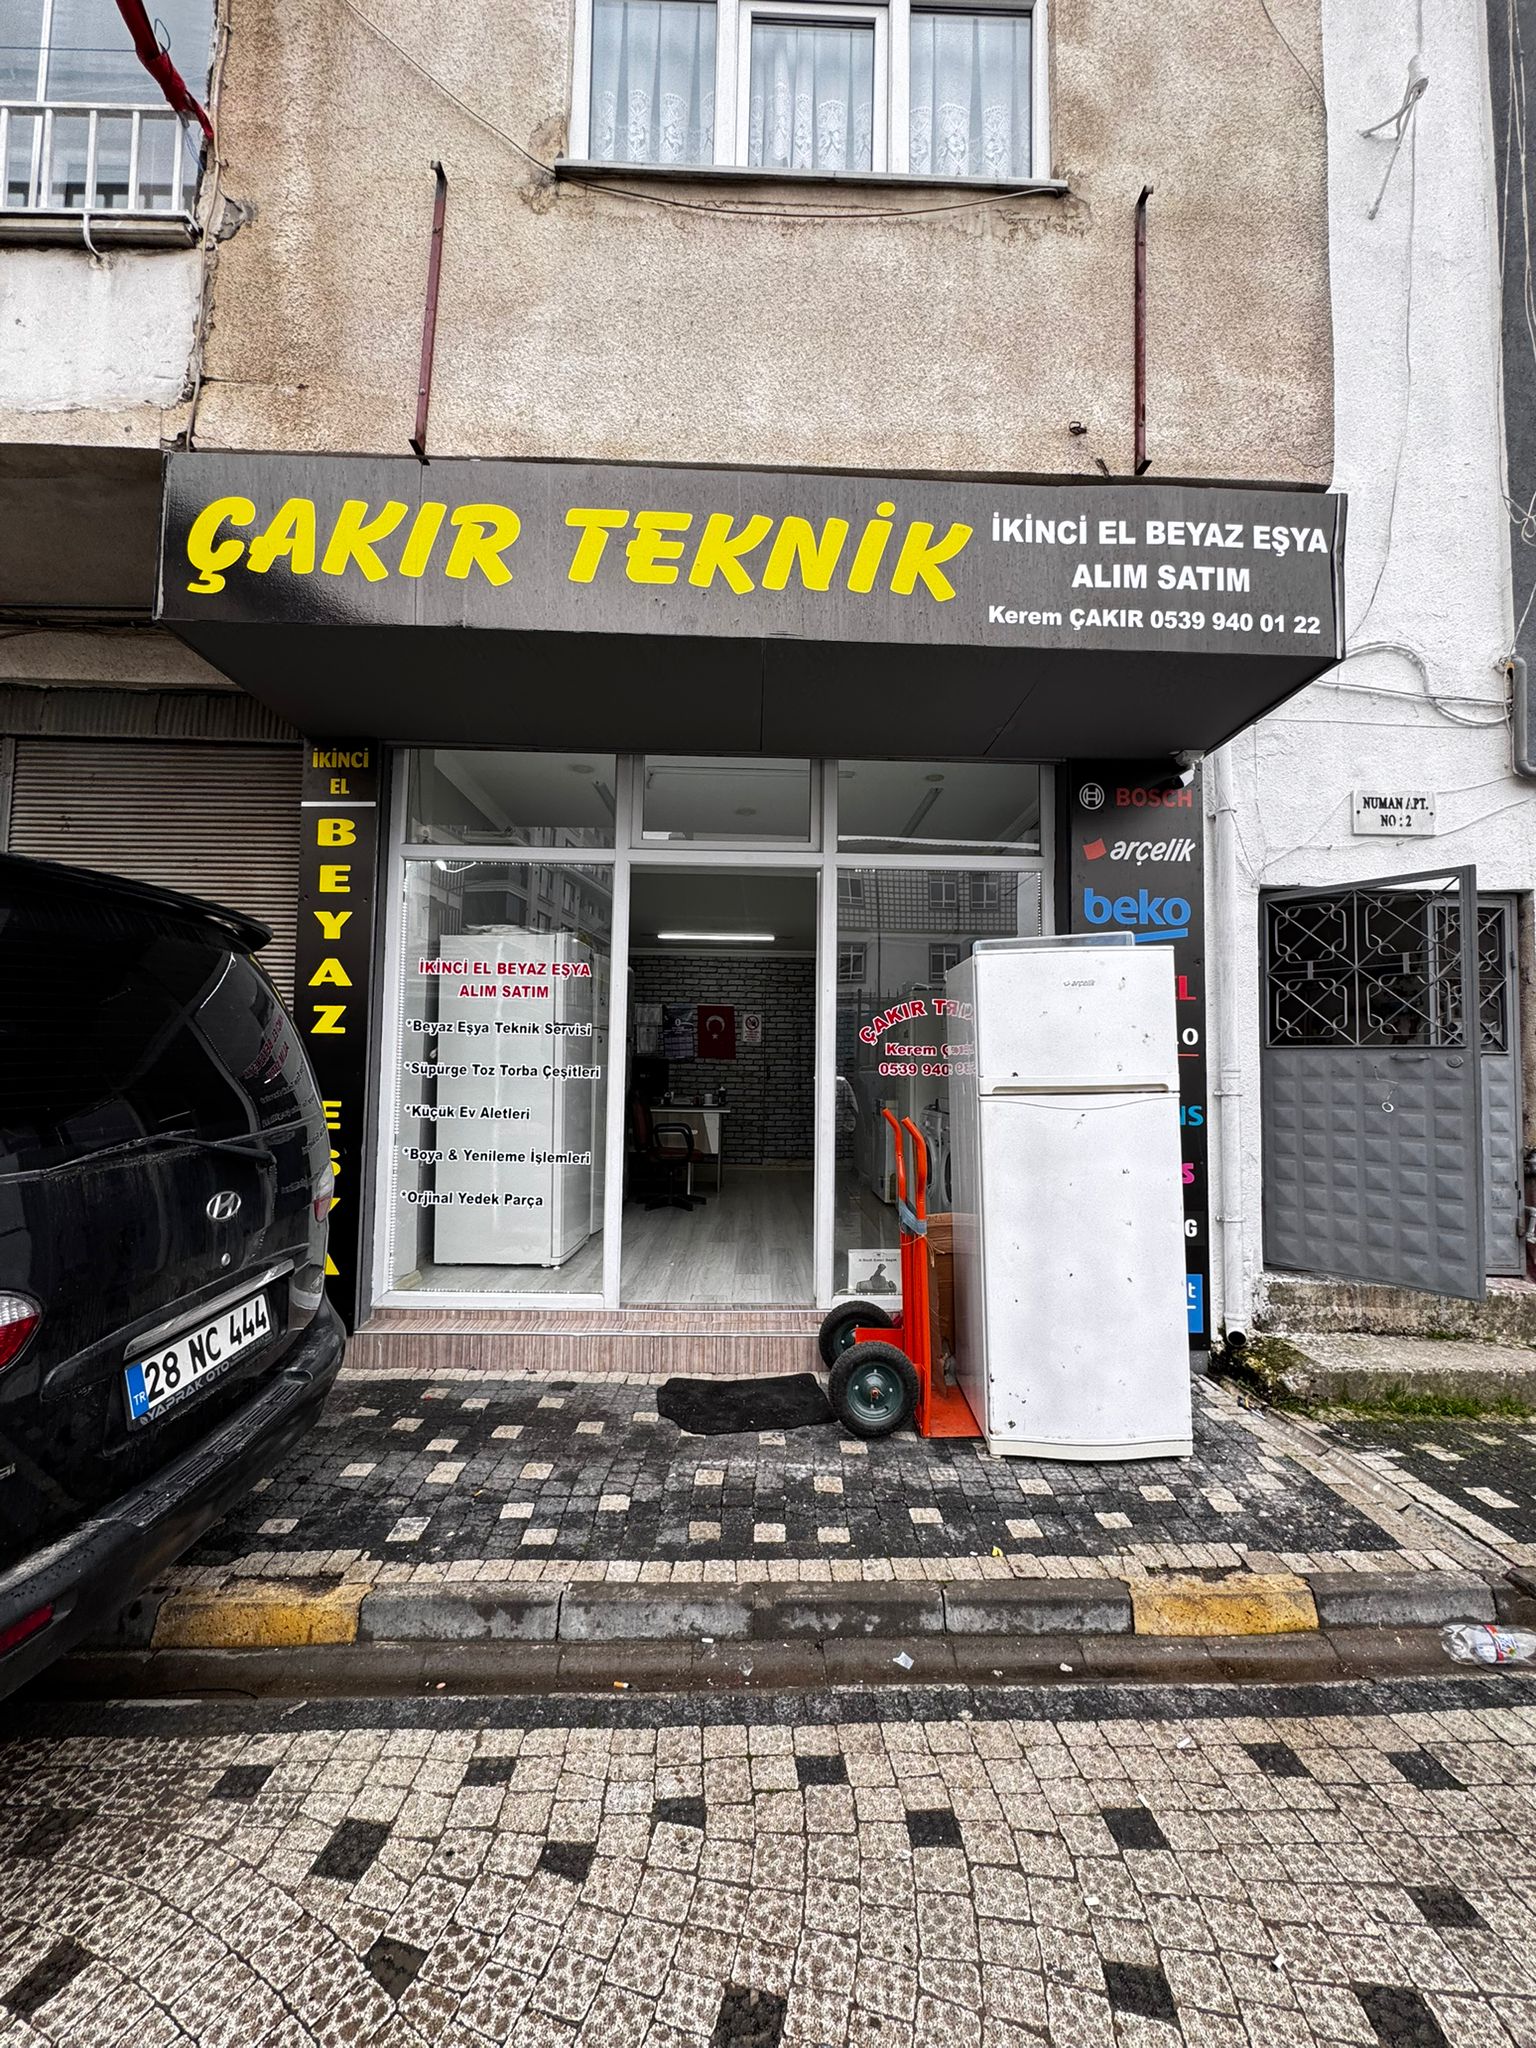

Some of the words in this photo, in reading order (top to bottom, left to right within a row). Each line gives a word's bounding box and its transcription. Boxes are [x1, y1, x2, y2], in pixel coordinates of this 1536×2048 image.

[992, 512, 1087, 545] İKİNCİ
[1099, 520, 1136, 545] EL
[1147, 521, 1243, 549] BEYAZ
[1253, 525, 1329, 557] EŞYA
[187, 496, 521, 594] ÇAKIR
[565, 501, 973, 602] TEKNİK
[1071, 563, 1147, 589] ALIM
[1157, 564, 1251, 593] SATIM
[988, 606, 1062, 626] Kerem
[1069, 608, 1144, 630] ÇAKIR
[1150, 610, 1206, 630] 0539
[1212, 612, 1253, 632] 940
[1260, 614, 1285, 633] 01
[1293, 615, 1321, 634] 22
[312, 748, 369, 769] İKİNCİ
[330, 778, 349, 795] EL
[1116, 788, 1193, 807] BOSCH
[1362, 797, 1403, 809] NUMAN
[1110, 838, 1196, 866] arçelik
[1084, 888, 1192, 926] beko
[308, 818, 357, 1034] BEYAZ
[419, 959, 468, 975] İKİNCİ
[473, 962, 490, 976] EL
[497, 962, 546, 976] BEYAZ
[551, 963, 591, 979] EŞYA
[459, 984, 497, 998] ALIM
[502, 985, 549, 998] SATIM
[457, 1021, 489, 1035] Eşya
[495, 1021, 540, 1034] Teknik
[544, 1023, 592, 1036] Servisi
[860, 1000, 927, 1045] ÇAKIR
[886, 1043, 937, 1056] Kerem
[472, 1064, 495, 1076] Toz
[500, 1064, 538, 1077] Torba
[542, 1064, 600, 1080] Çeşitleri
[879, 1063, 917, 1076] 0539
[922, 1064, 950, 1076] 940
[459, 1107, 476, 1119] Ev
[480, 1106, 530, 1120] Aletleri
[448, 1150, 458, 1161] &
[463, 1149, 526, 1163] Yenileme
[530, 1148, 591, 1166] İşlemleri
[458, 1192, 500, 1206] Yedek
[504, 1193, 544, 1209] Parça
[133, 1391, 147, 1406] TR
[144, 1351, 181, 1402] 28
[188, 1326, 222, 1375] NC
[229, 1299, 268, 1346] 444
[146, 1379, 204, 1422] YAPRAK
[205, 1360, 230, 1383] OTO
